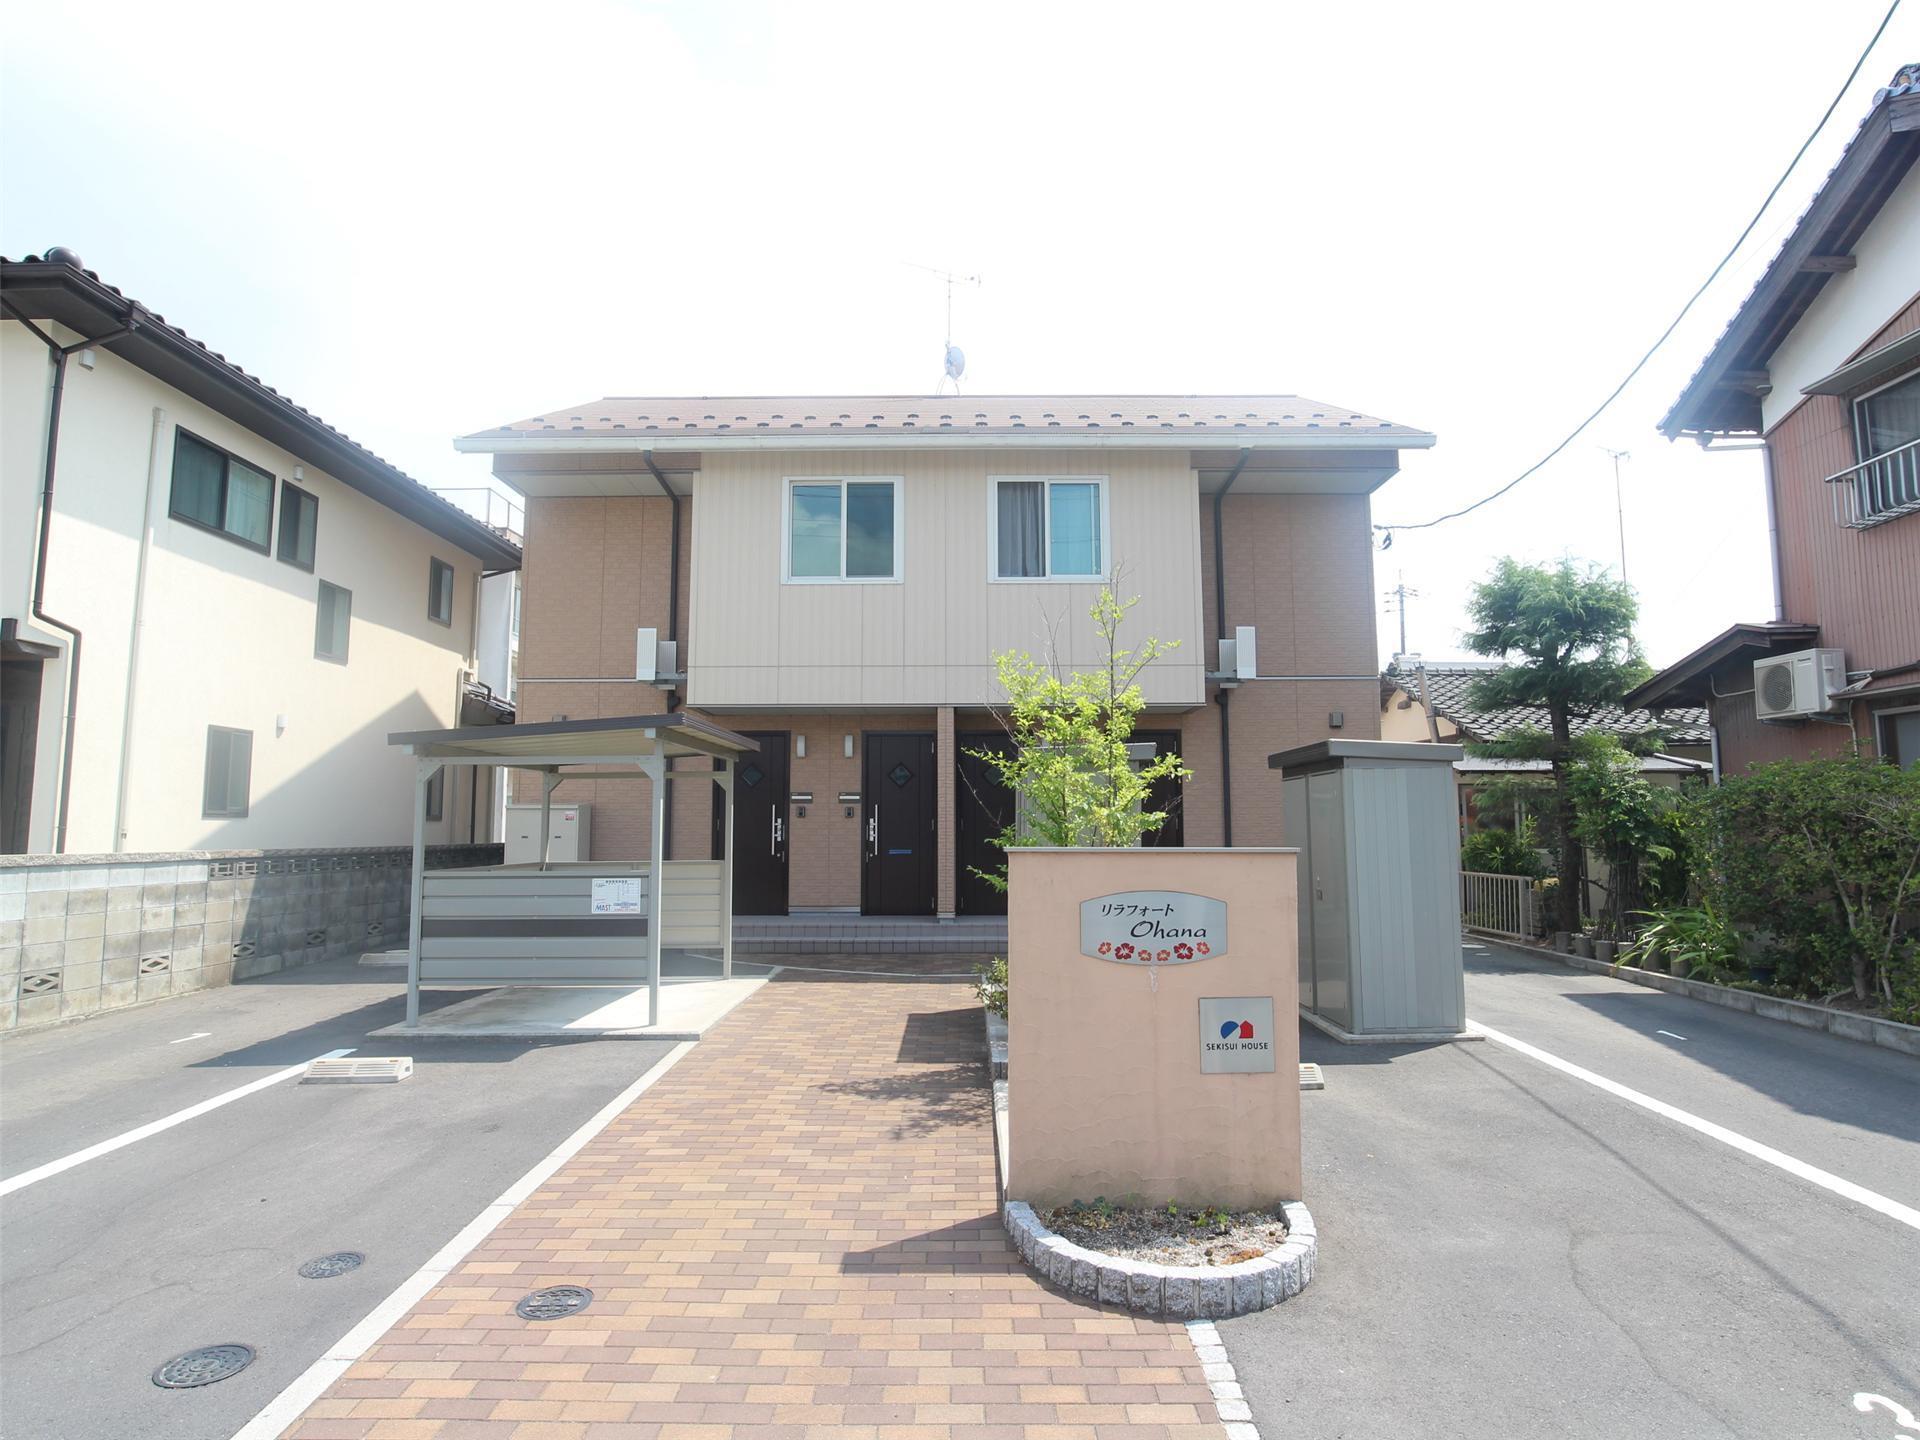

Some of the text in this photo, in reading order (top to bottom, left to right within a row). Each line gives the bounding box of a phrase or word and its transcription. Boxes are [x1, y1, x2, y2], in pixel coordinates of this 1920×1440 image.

[1102, 903, 1174, 916] リラフォート
[1130, 920, 1206, 939] Ohana
[1206, 1042, 1269, 1051] SEKISUI HOUSE
